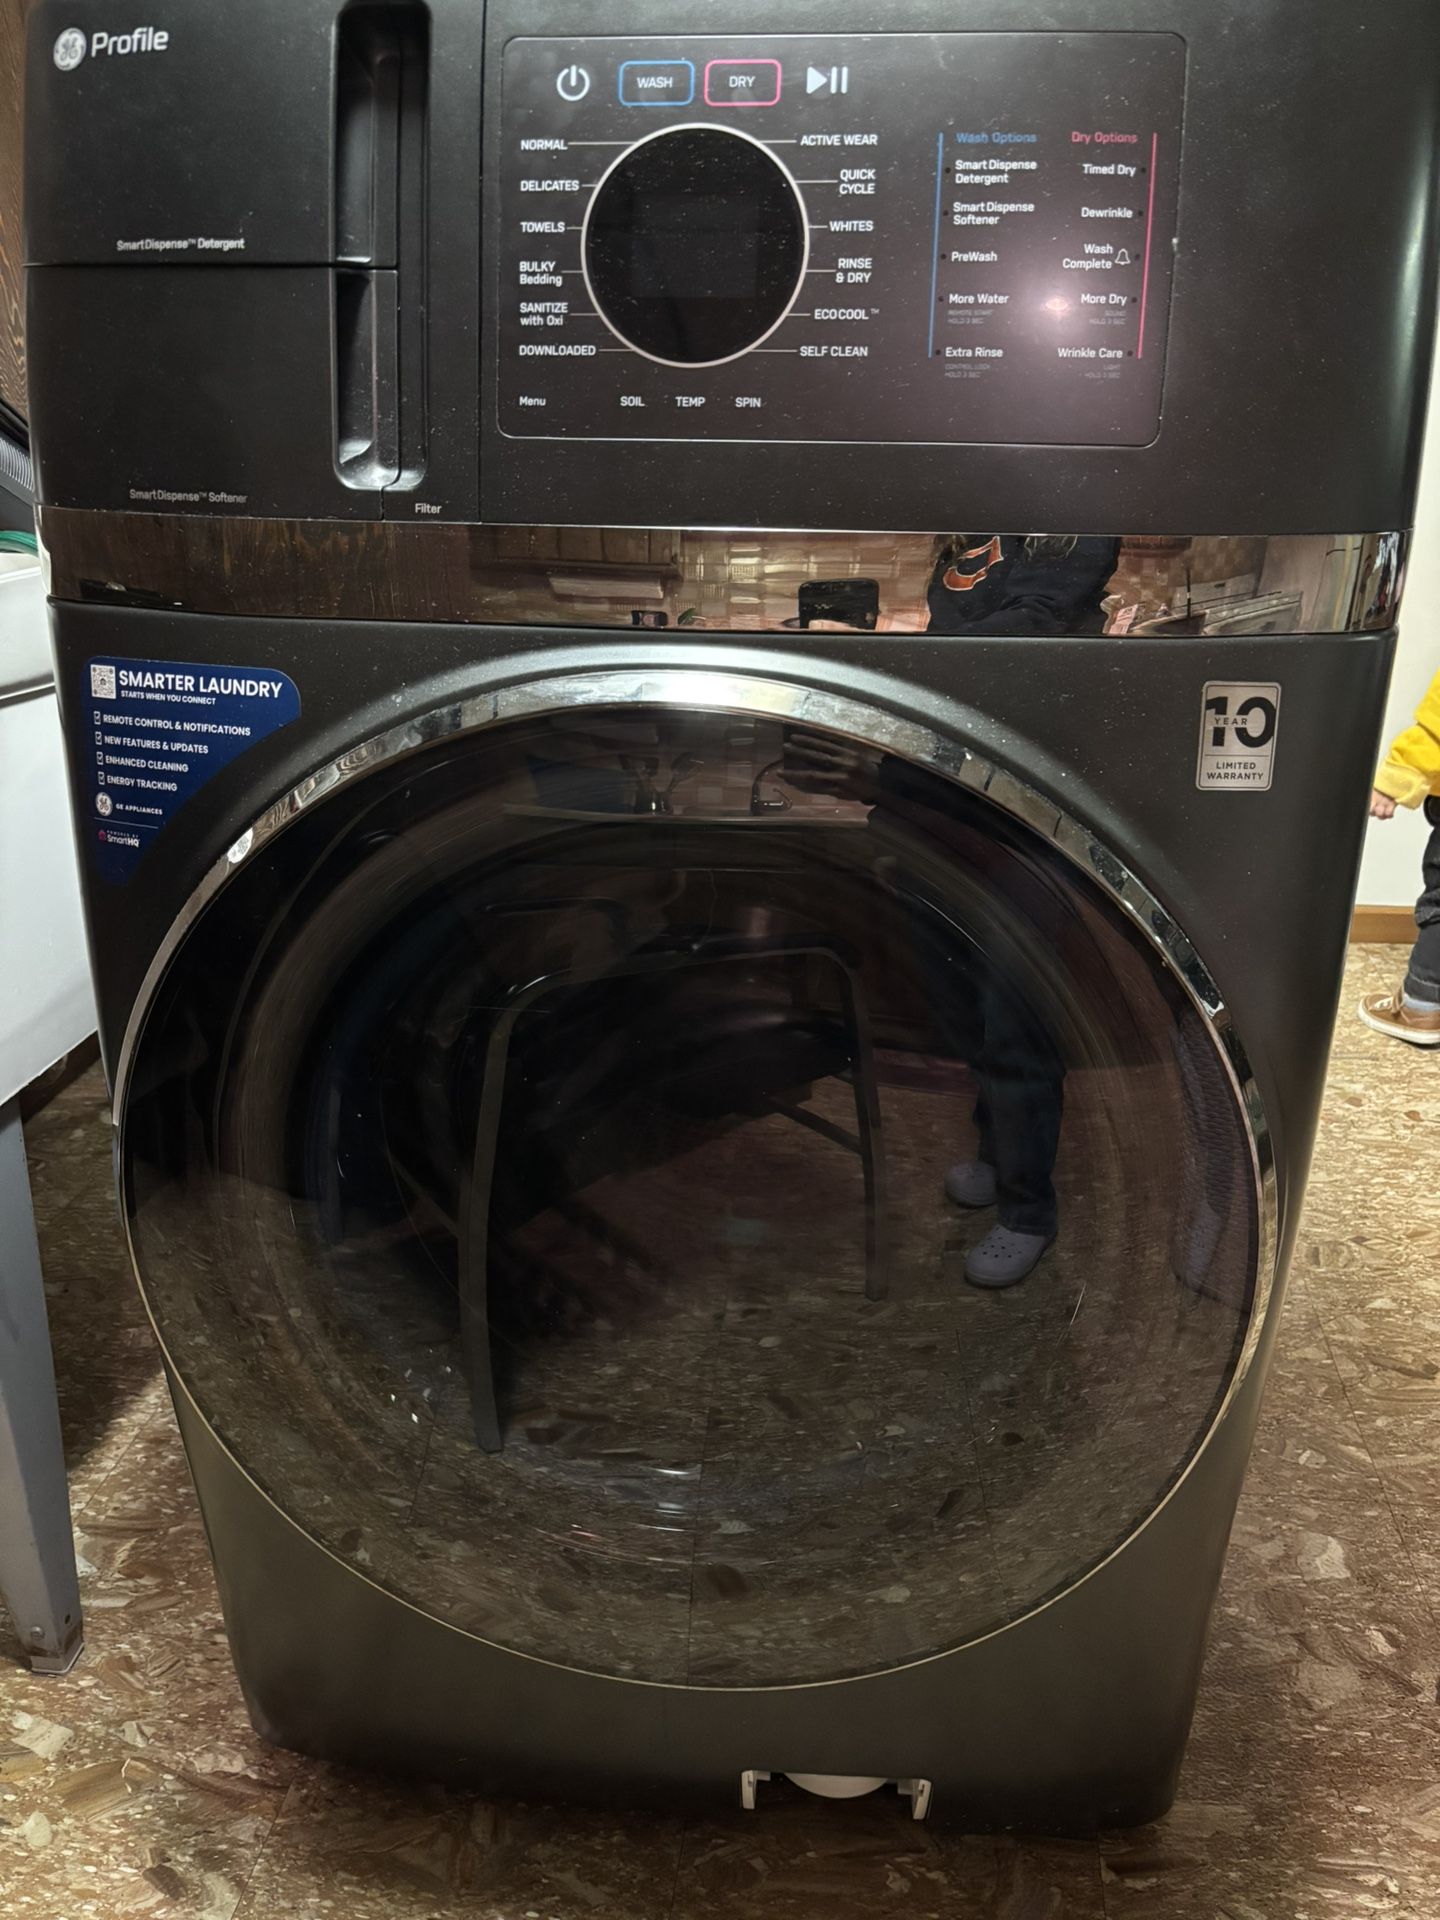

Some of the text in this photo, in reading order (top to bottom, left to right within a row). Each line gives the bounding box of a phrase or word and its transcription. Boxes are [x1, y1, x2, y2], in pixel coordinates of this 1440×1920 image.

[91, 26, 169, 58] Profile
[637, 77, 673, 89] WASH
[729, 76, 756, 88] DRY
[800, 134, 878, 147] ACTIVE WEAR
[956, 132, 1037, 145] Wash Options
[1071, 131, 1138, 144] Dry Options
[520, 140, 568, 151] NORMAL
[839, 168, 876, 181] QUICK
[1082, 163, 1136, 177] Timed Dry
[955, 173, 1009, 186] Detergent
[520, 180, 579, 192] DELICATES
[839, 183, 875, 195] CYCLE
[1081, 206, 1133, 218] Dewrinkle
[953, 213, 1000, 225] Softener
[520, 221, 565, 233] TOWELS
[829, 220, 874, 232] WHITES
[197, 237, 245, 251] Detergent
[1084, 243, 1113, 255] Wash
[951, 250, 997, 263] PreWash
[519, 261, 556, 273] BULKY
[838, 258, 872, 269] RINSE
[1062, 257, 1113, 271] Complete
[519, 274, 562, 287] Bedding
[835, 271, 871, 284] & DRY
[948, 293, 1010, 304] More Water
[1081, 293, 1128, 307] More Dry
[519, 303, 568, 315] SANITIZE
[519, 315, 564, 327] with Oxi
[519, 345, 596, 356] DOWNLOADED
[800, 346, 868, 357] SELF CLEAN
[945, 346, 1004, 358] Extra Rinse
[1057, 347, 1123, 359] Wrinkle Care
[519, 395, 546, 407] Menu
[620, 395, 645, 407] SOIL
[676, 395, 706, 407] TEMP
[735, 396, 761, 408] SPIN
[208, 492, 248, 504] Softener
[414, 502, 442, 514] Filter
[119, 670, 283, 698] SMARTER LAUNDRY
[121, 690, 216, 706] STARTS WHEN YOU CONNECT
[103, 714, 251, 737] REMOTE CONTROL & NOTIFICATIONS
[1205, 696, 1277, 748] 10
[1214, 717, 1248, 726] YEAR
[104, 735, 209, 755] NEW FEATURES & UPDATES
[105, 755, 190, 773] ENHANCED CLEANING
[1216, 762, 1256, 770] LIMITED
[1207, 771, 1264, 780] WARRANTY
[107, 775, 178, 792] ENERGY TRACKING
[125, 805, 163, 816] APPLIANCES
[106, 834, 140, 848] SmartHQ
